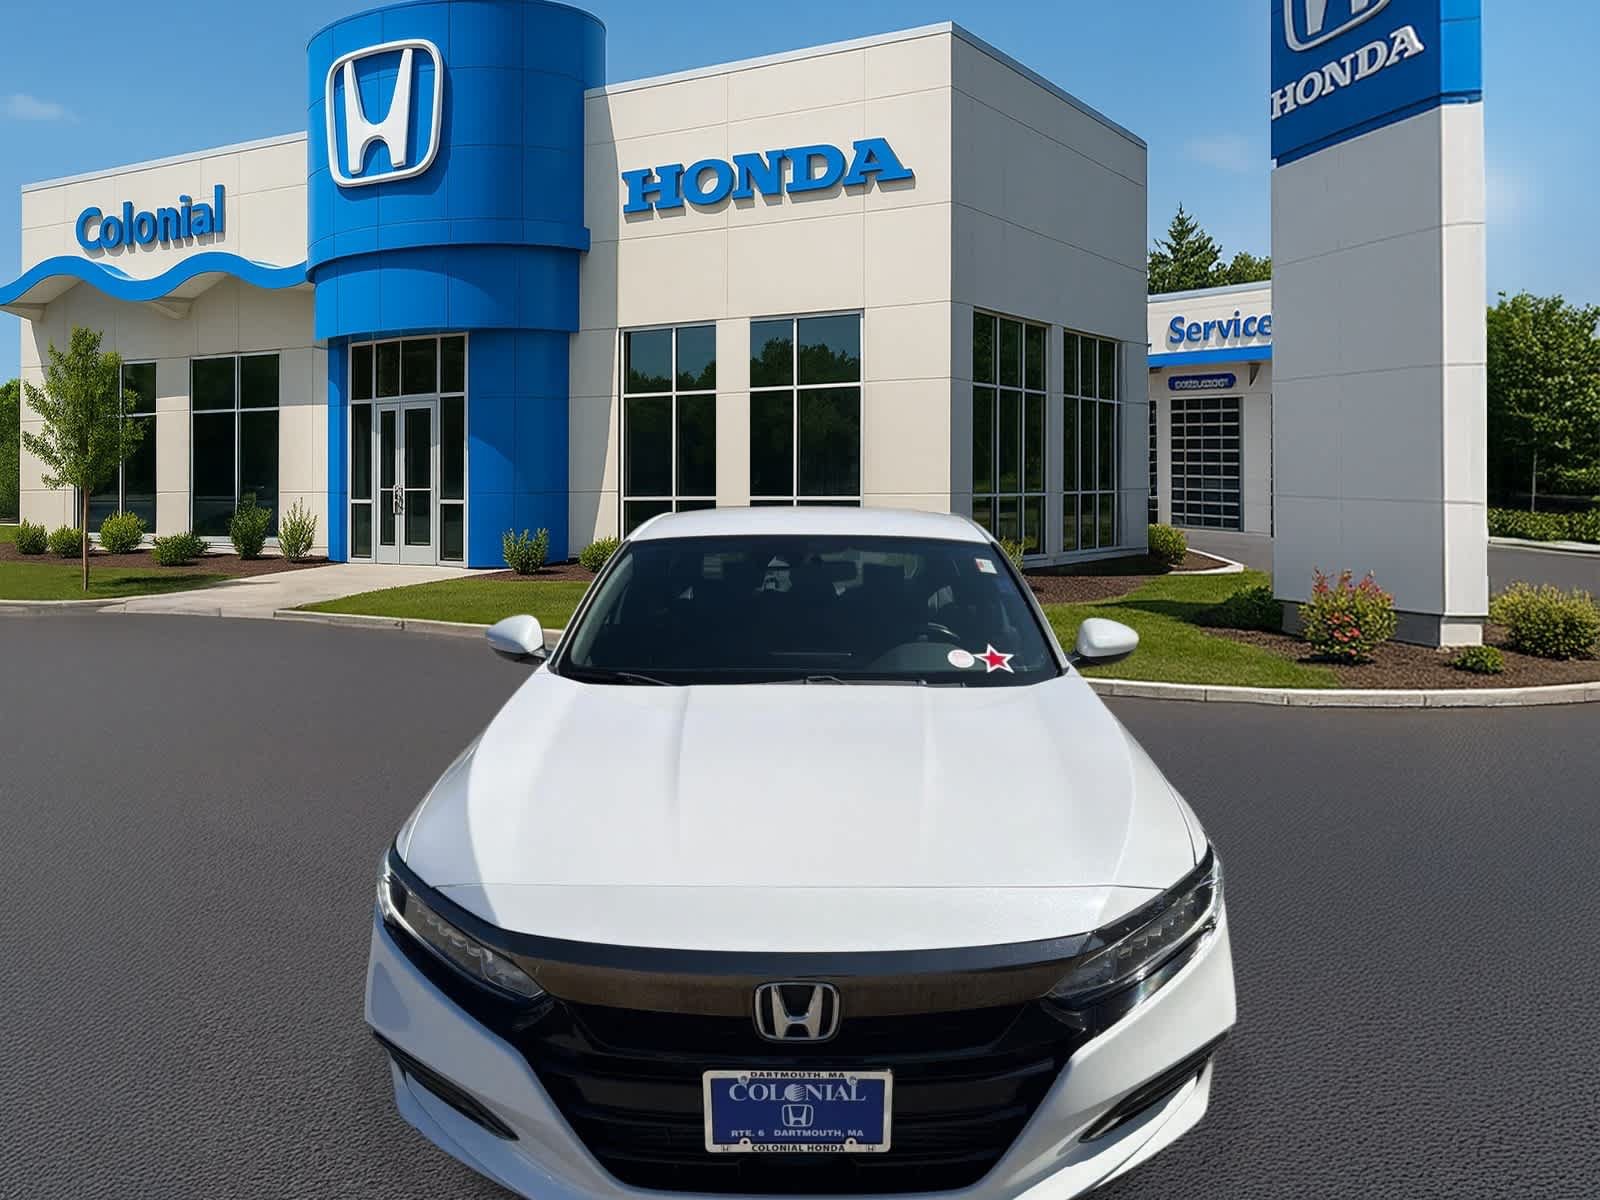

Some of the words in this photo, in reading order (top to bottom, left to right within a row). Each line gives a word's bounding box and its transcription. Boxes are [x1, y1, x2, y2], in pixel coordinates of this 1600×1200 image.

[1271, 25, 1424, 120] HONDA
[621, 137, 914, 214] HONDA
[75, 184, 224, 250] Colonial
[1169, 309, 1272, 344] Service
[729, 1083, 866, 1101] COLONIAL
[828, 1071, 845, 1079] MA
[751, 1144, 804, 1153] COLONIAL
[807, 1144, 845, 1153] HONDA
